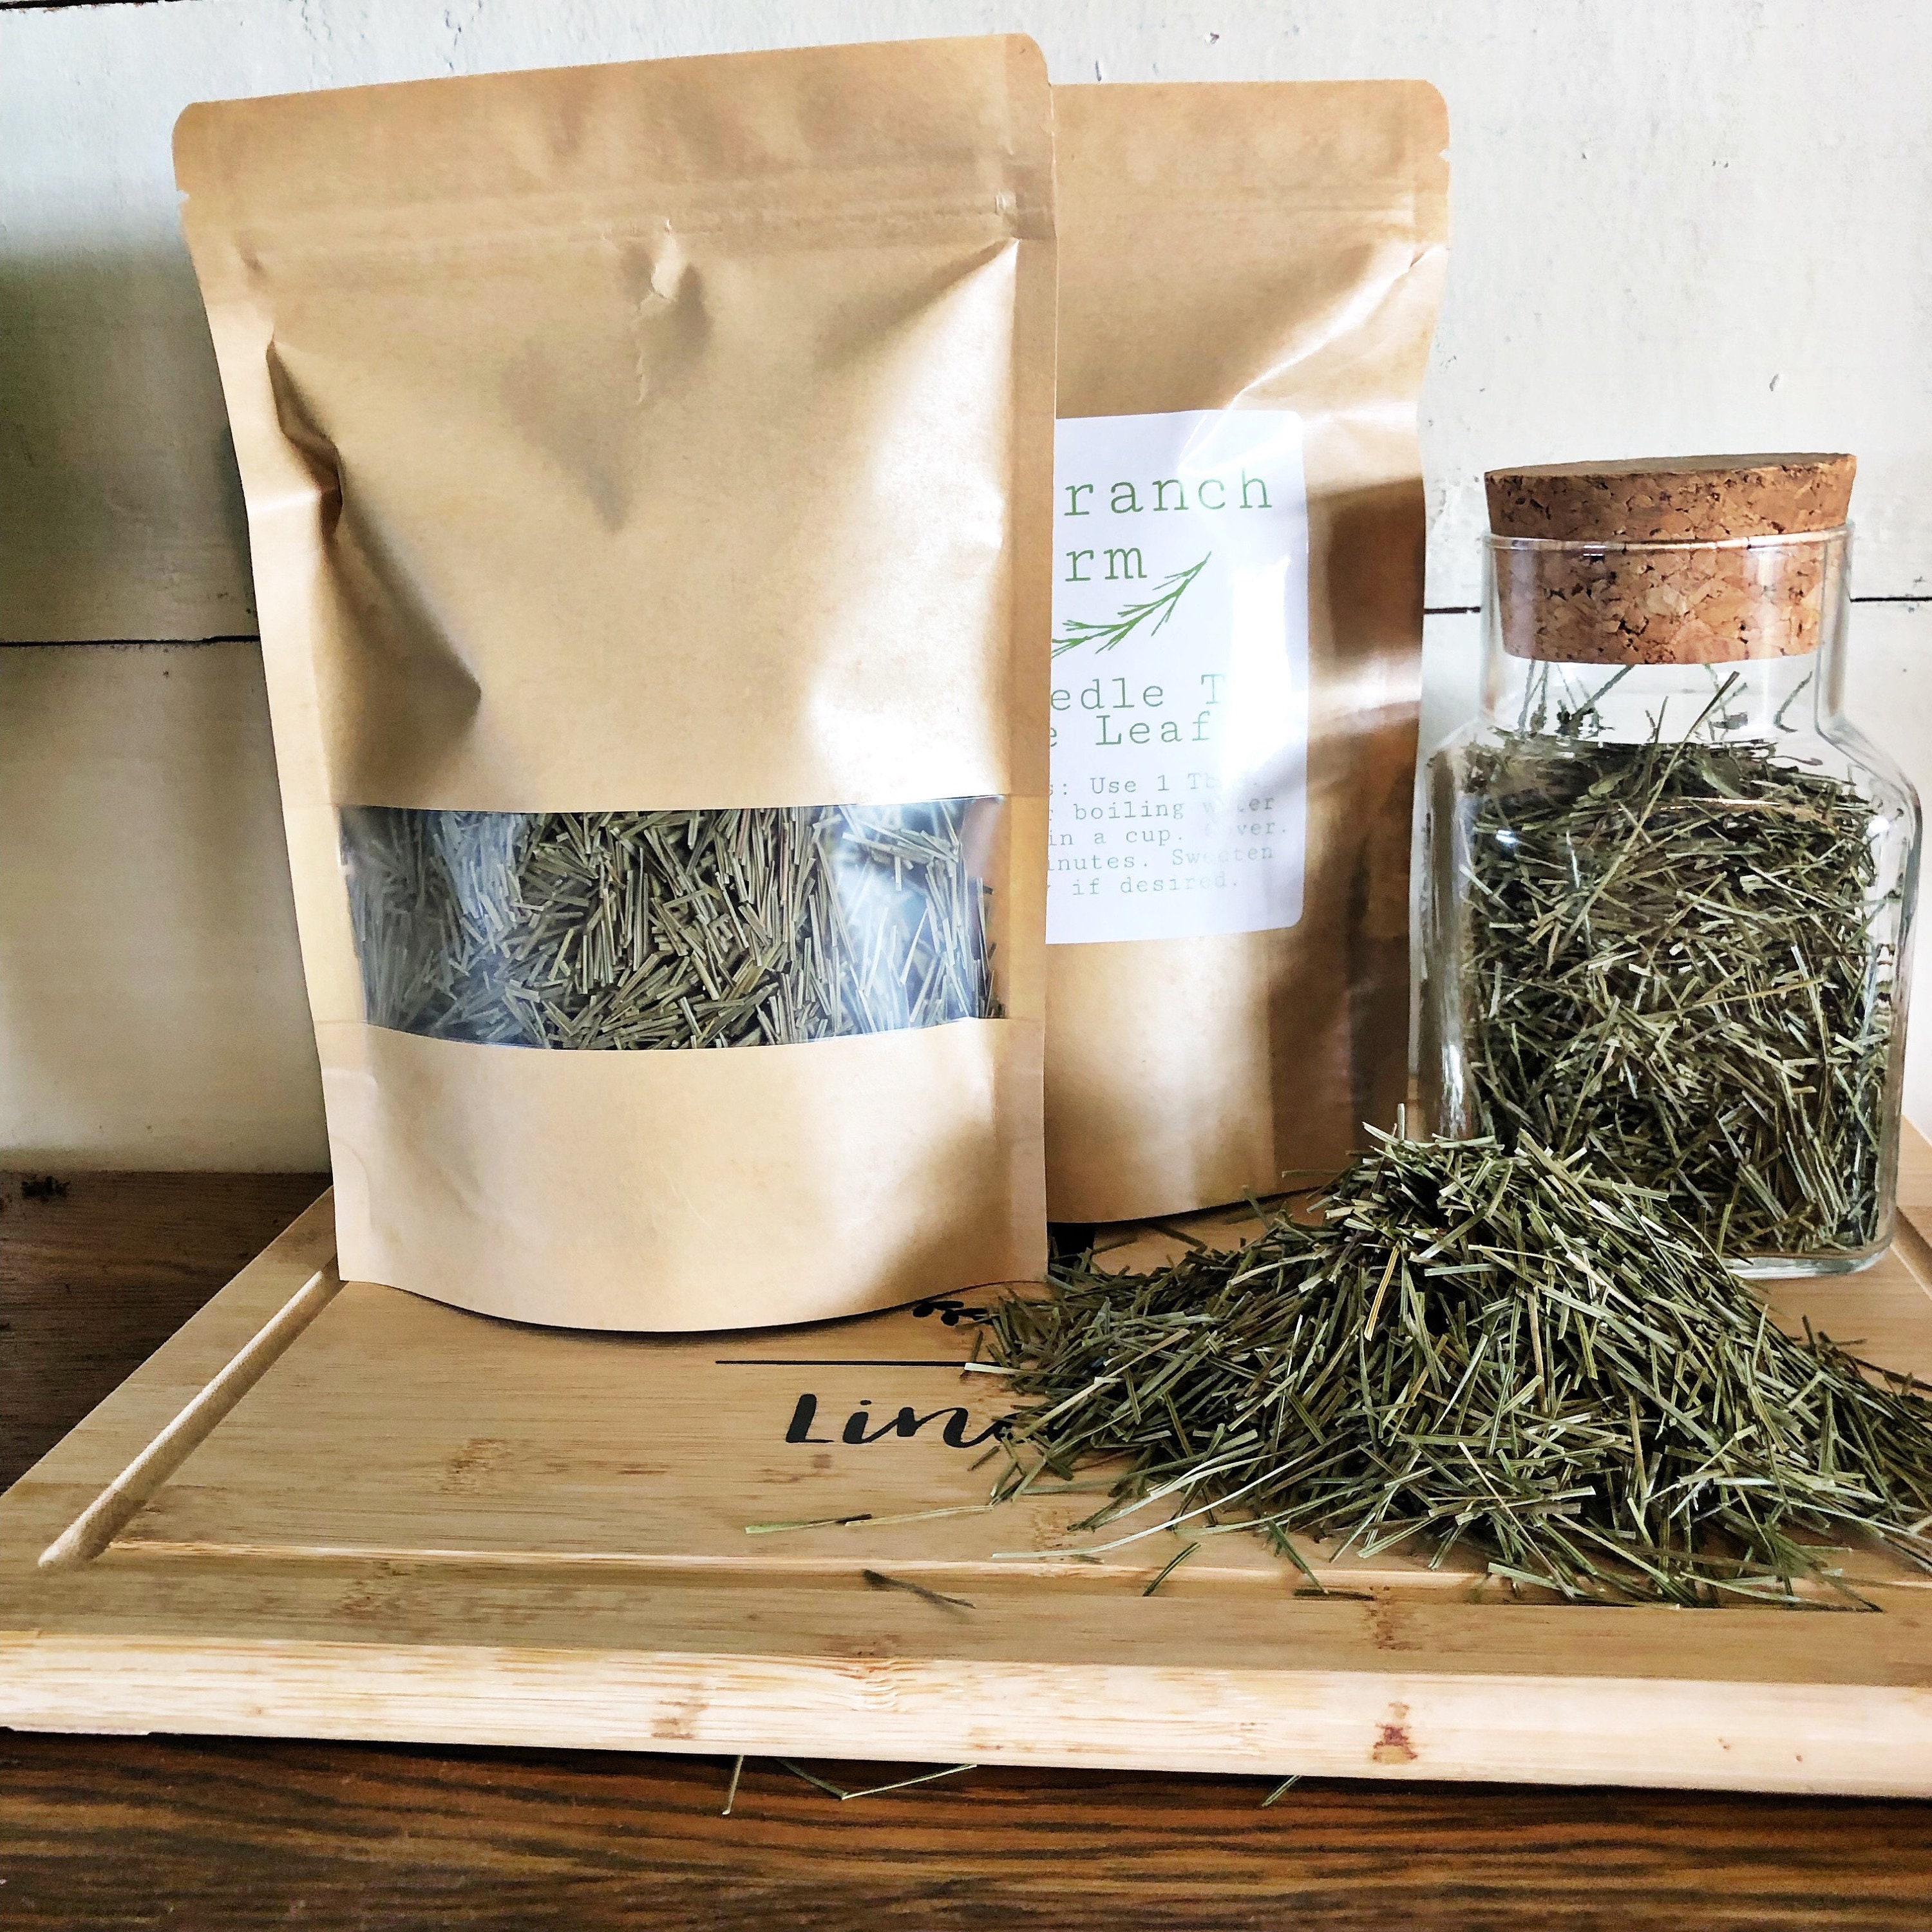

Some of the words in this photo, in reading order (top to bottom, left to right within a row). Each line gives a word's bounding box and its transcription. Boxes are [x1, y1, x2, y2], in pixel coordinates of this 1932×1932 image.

[1064, 468, 1273, 516] ranch
[1065, 547, 1148, 582] rm
[1050, 677, 1164, 711] edle
[1095, 710, 1211, 746] Leaf
[1090, 777, 1137, 794] Use
[1157, 775, 1170, 791] 1
[1074, 800, 1184, 820] boiling
[1094, 832, 1106, 844] a
[1126, 828, 1183, 846] cup.
[1073, 878, 1101, 896] if
[1120, 871, 1237, 894] desired.
